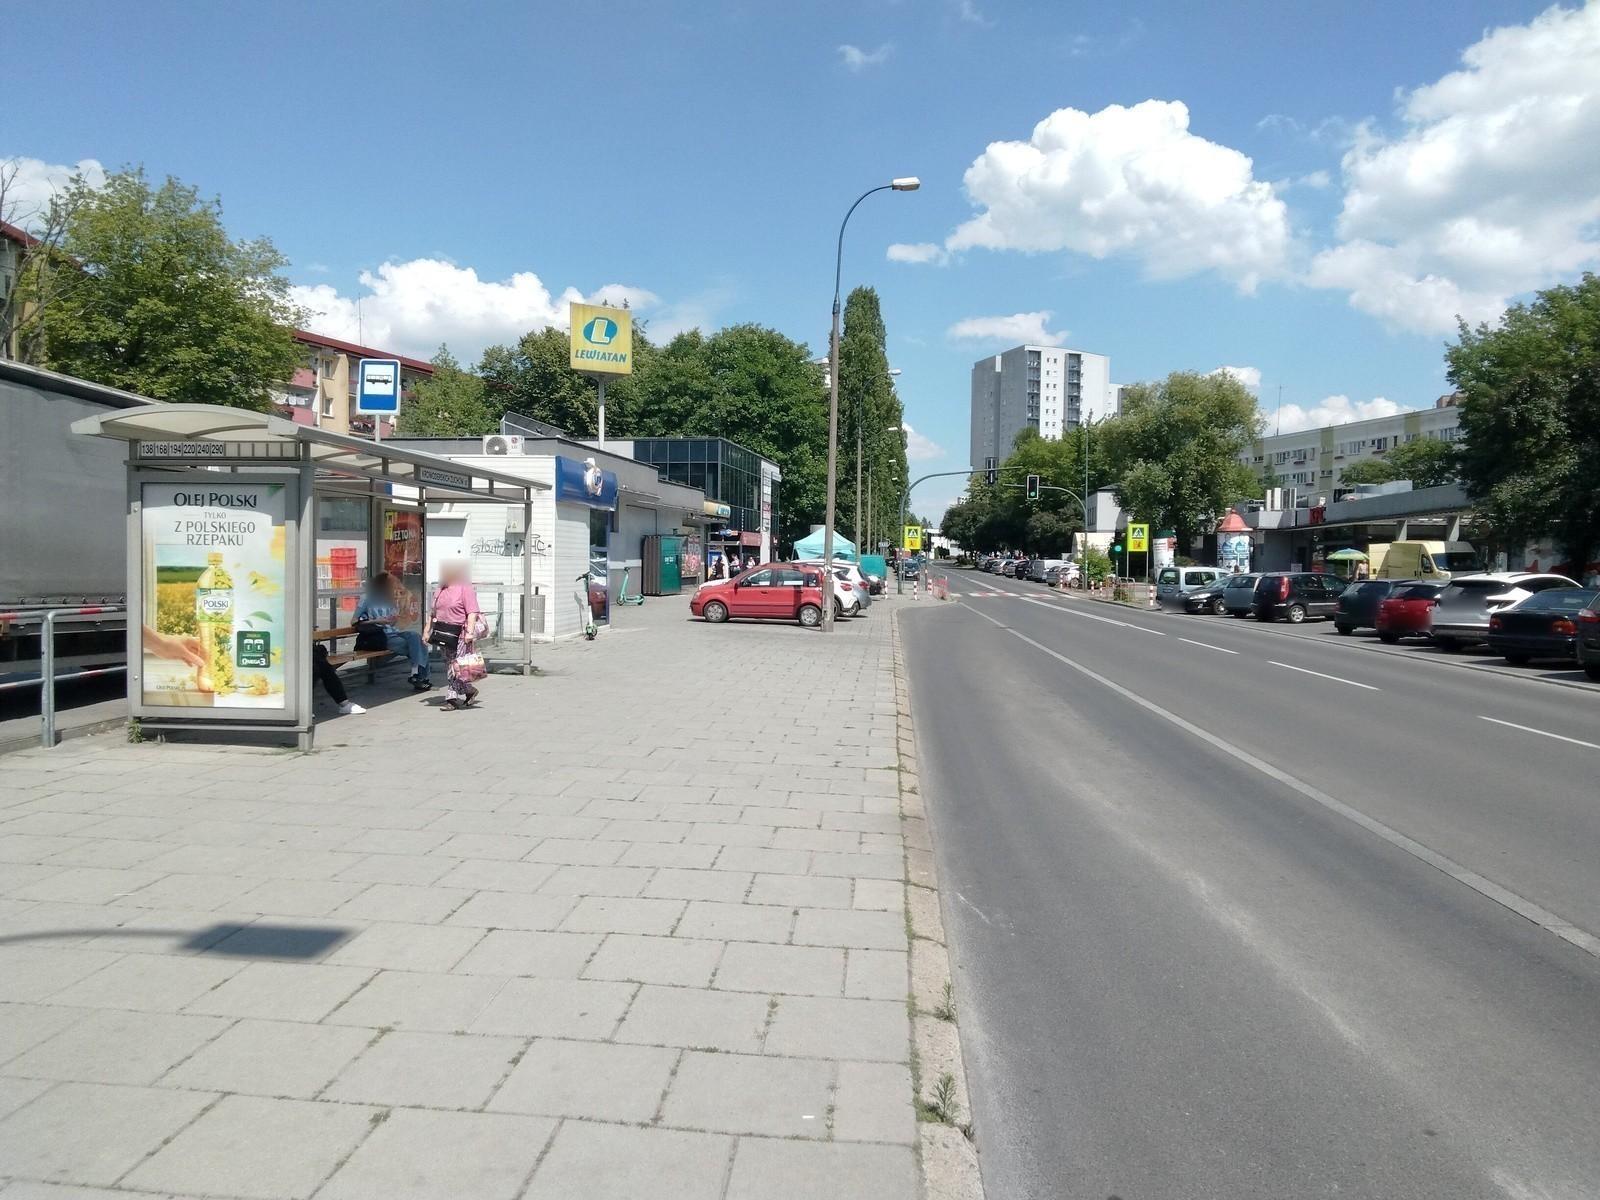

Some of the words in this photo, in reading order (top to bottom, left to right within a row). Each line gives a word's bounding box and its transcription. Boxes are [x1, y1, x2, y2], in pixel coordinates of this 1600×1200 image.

[575, 349, 627, 363] LEWIATAN
[142, 442, 153, 454] 138
[156, 442, 168, 454] 168
[170, 442, 181, 454] 194
[184, 442, 196, 454] 220
[198, 442, 210, 454] 240
[212, 442, 224, 454] 290
[174, 492, 205, 507] OLEJ
[209, 492, 257, 508] POLSKI
[174, 521, 182, 532] Z
[186, 521, 256, 534] POLSKIEGO
[186, 534, 244, 546] RZEPAKU
[204, 600, 229, 608] POLSKI
